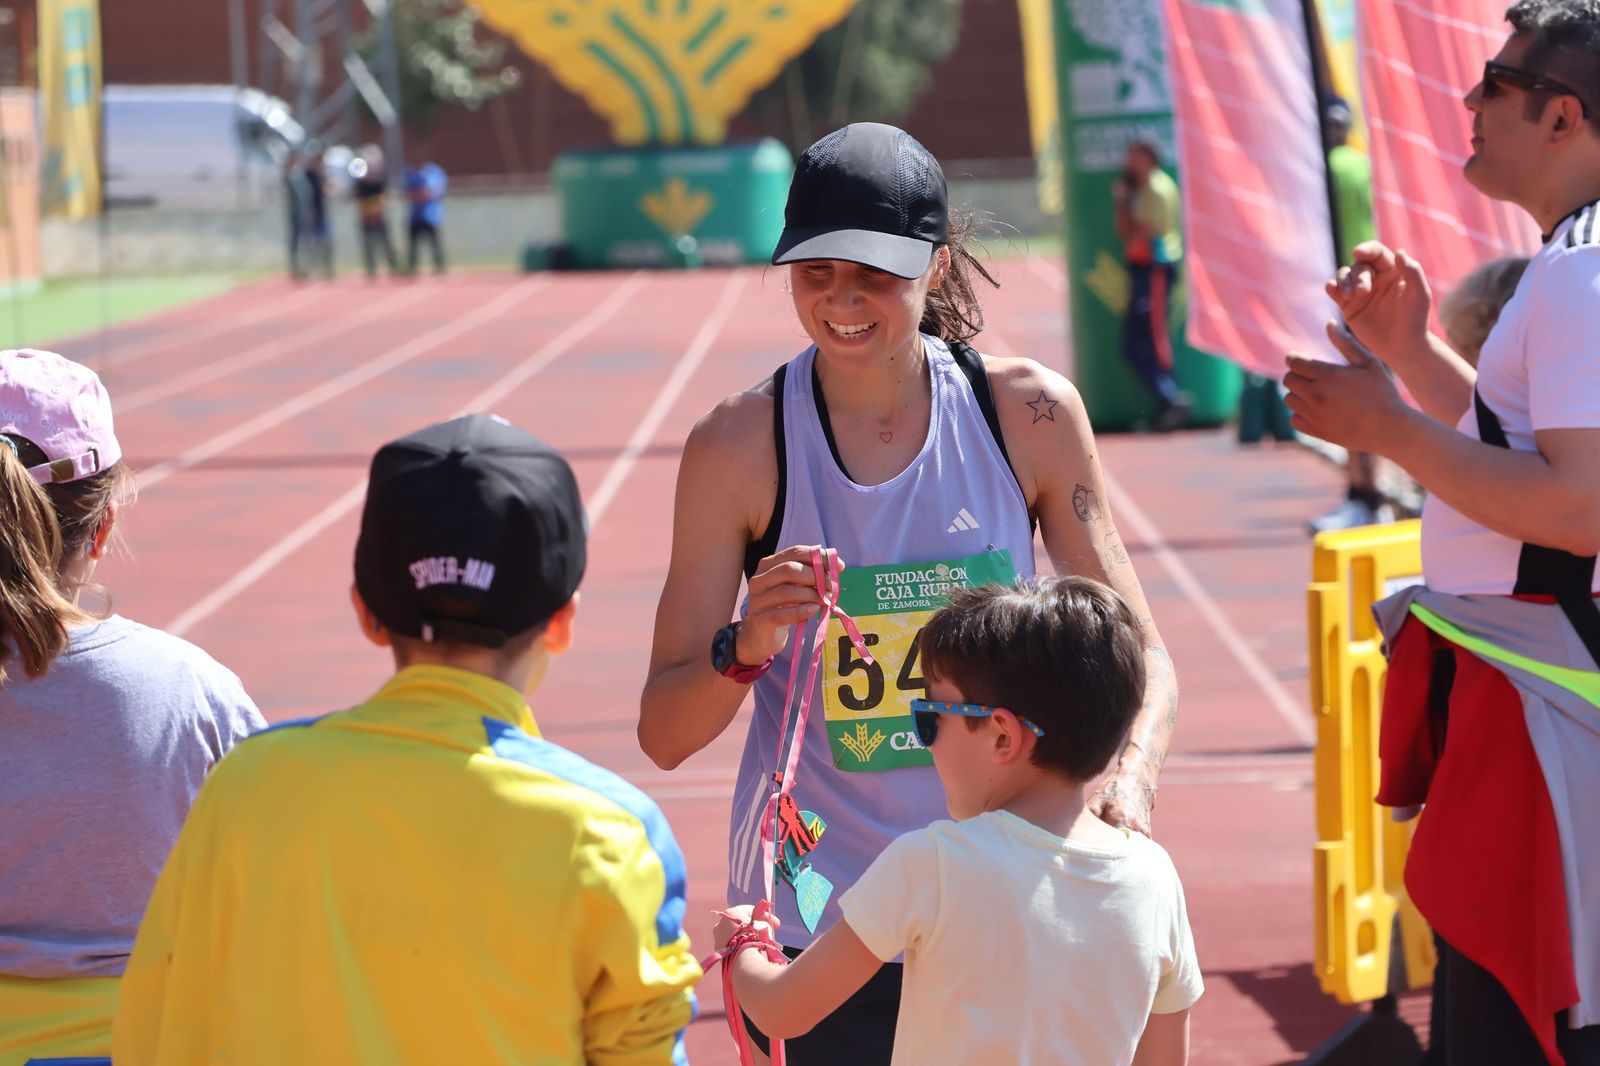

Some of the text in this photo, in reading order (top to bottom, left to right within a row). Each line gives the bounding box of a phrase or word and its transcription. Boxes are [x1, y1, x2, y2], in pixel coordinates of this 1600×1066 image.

[876, 585, 915, 600] CAJA
[878, 599, 931, 610] DE ZAMORA
[890, 731, 925, 751] CA
